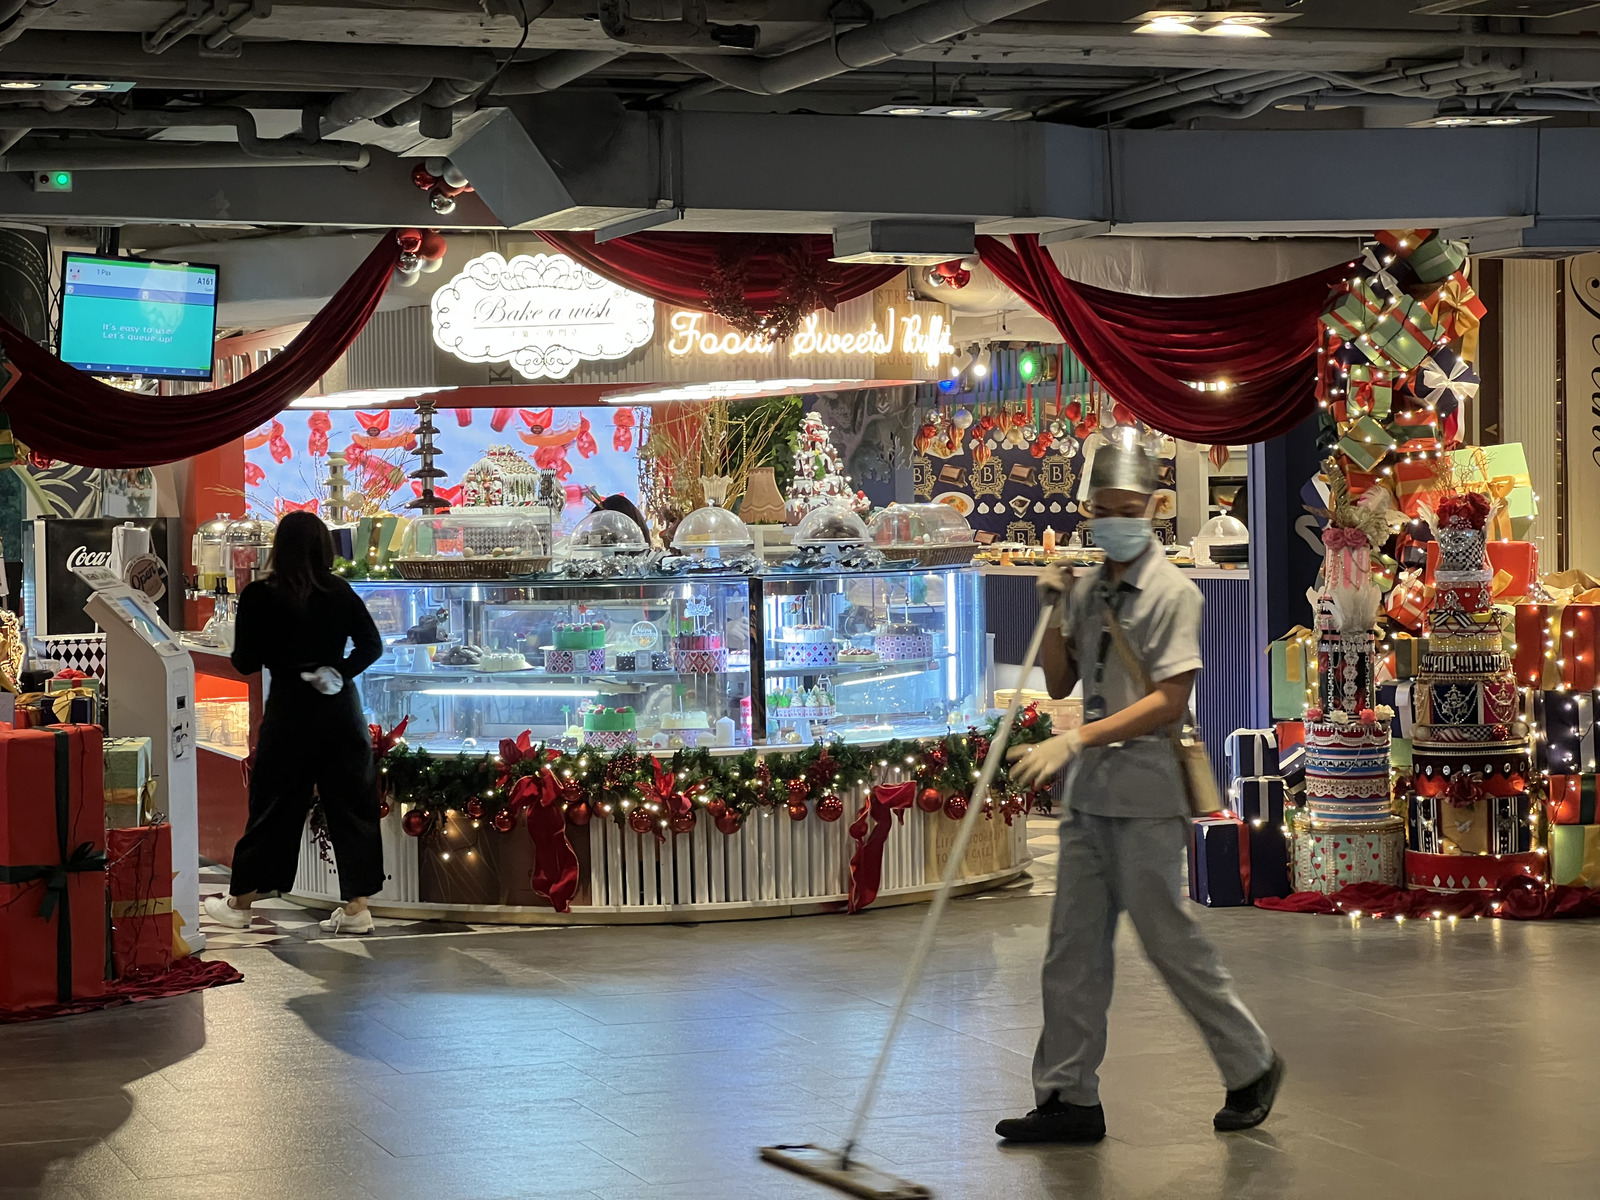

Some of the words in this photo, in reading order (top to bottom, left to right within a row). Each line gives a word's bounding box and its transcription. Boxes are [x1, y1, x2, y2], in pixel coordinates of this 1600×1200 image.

[197, 277, 213, 286] A161
[473, 295, 543, 323] Bake
[548, 308, 562, 320] a
[567, 298, 611, 320] wish
[119, 325, 140, 334] easy
[102, 331, 125, 340] Let's
[127, 334, 156, 342] queue
[159, 336, 173, 344] up!
[983, 467, 993, 482] B
[1052, 466, 1062, 481] B
[131, 565, 157, 592] Open
